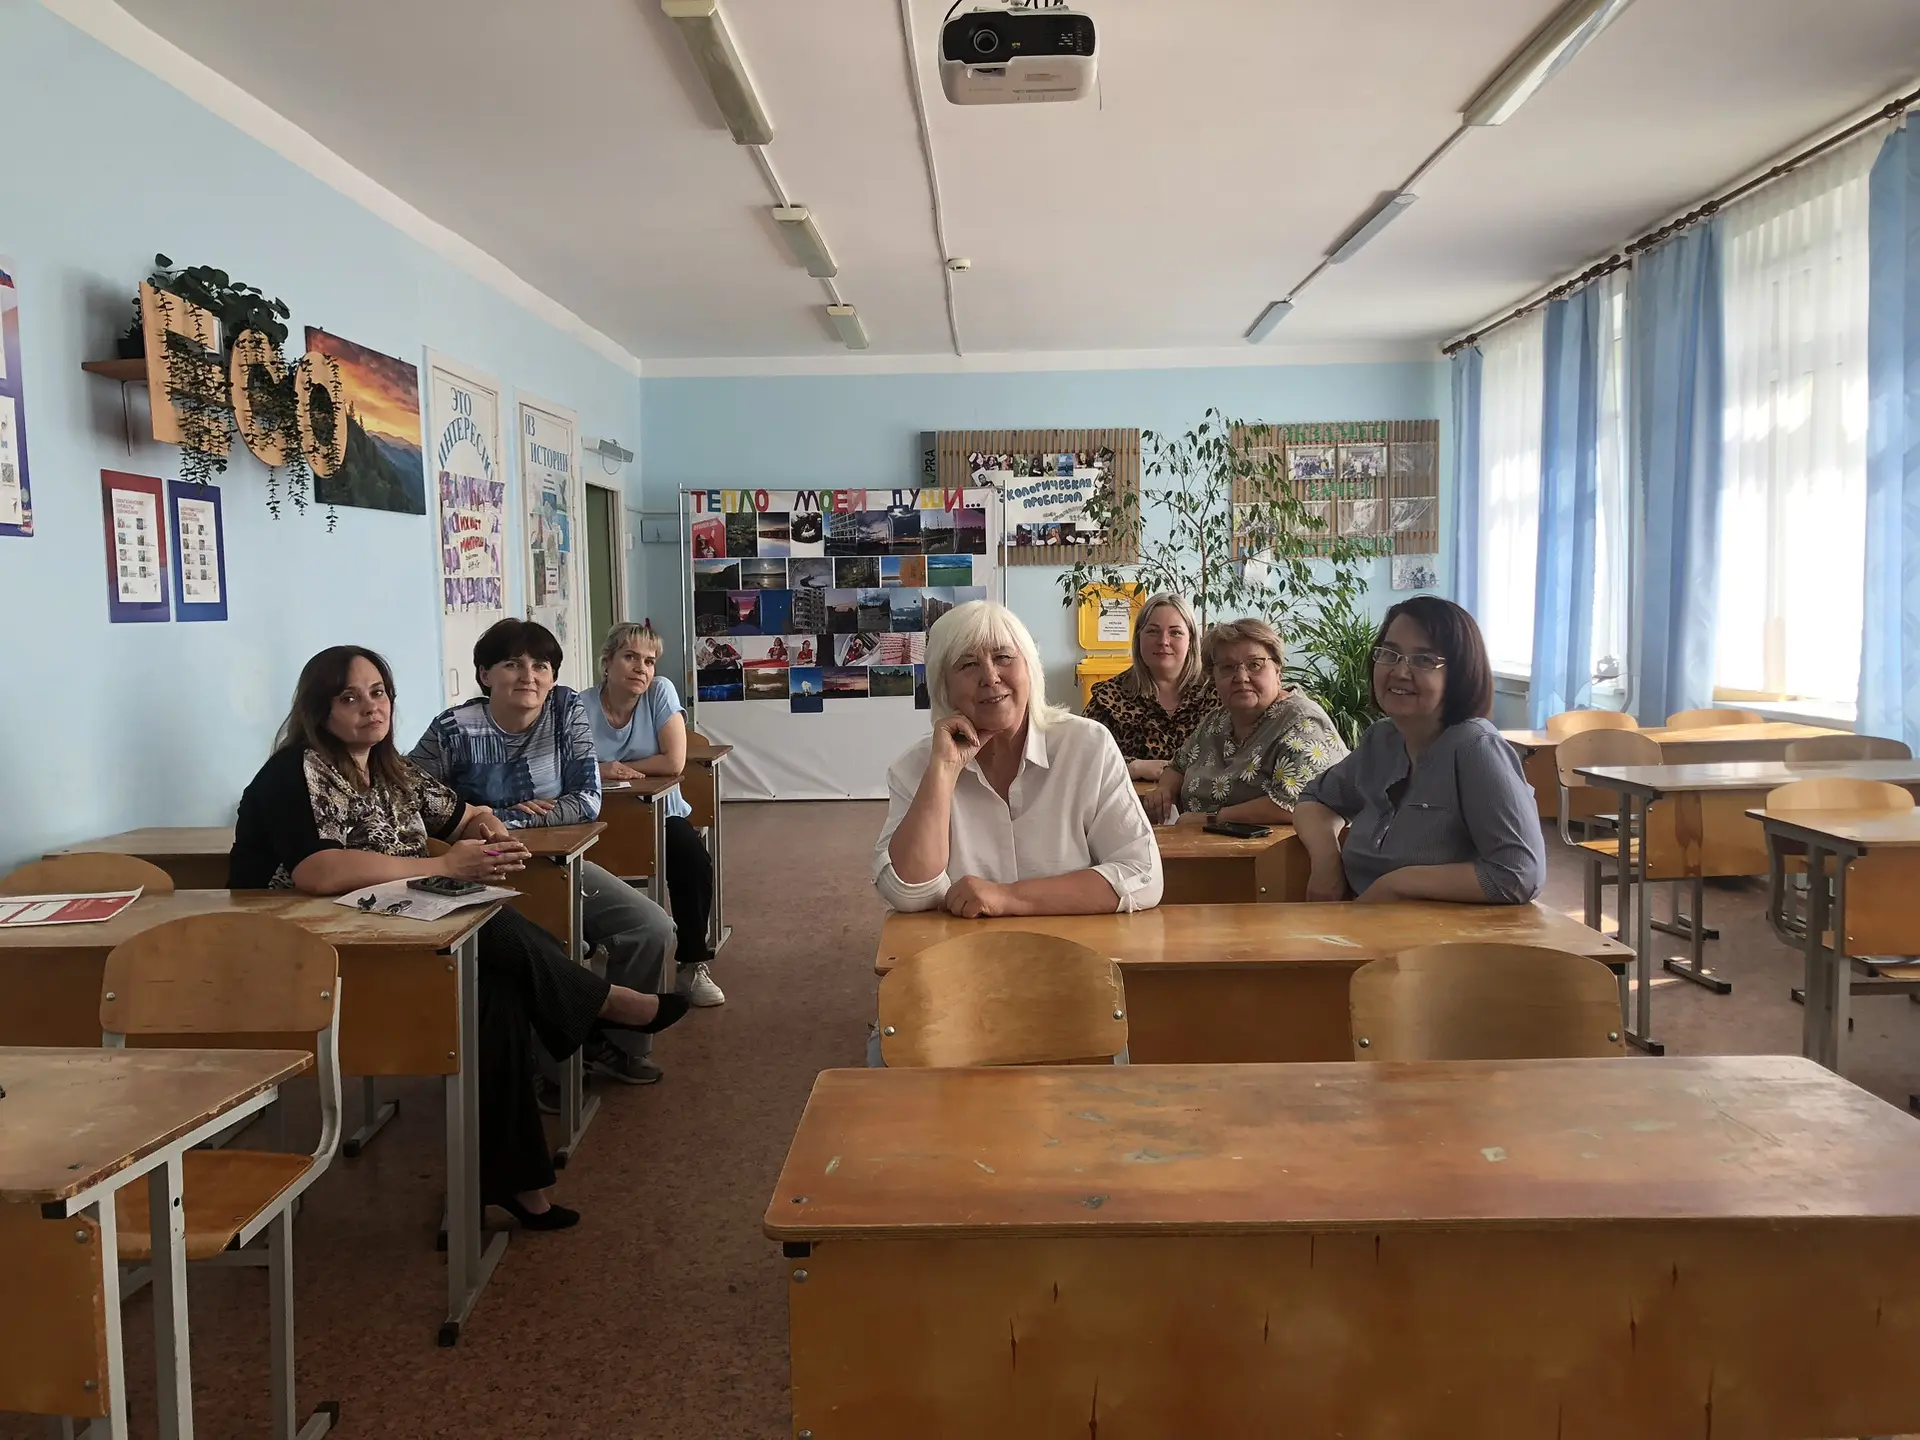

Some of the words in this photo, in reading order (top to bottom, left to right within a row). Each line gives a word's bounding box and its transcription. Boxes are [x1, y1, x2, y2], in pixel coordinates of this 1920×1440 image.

[450, 387, 472, 416] ЭТО
[525, 413, 536, 436] ИЗ
[530, 442, 568, 472] ИСТОРИИ
[691, 488, 769, 514] ТЕПЛО
[1023, 491, 1083, 509] ПРОБЛЕМА
